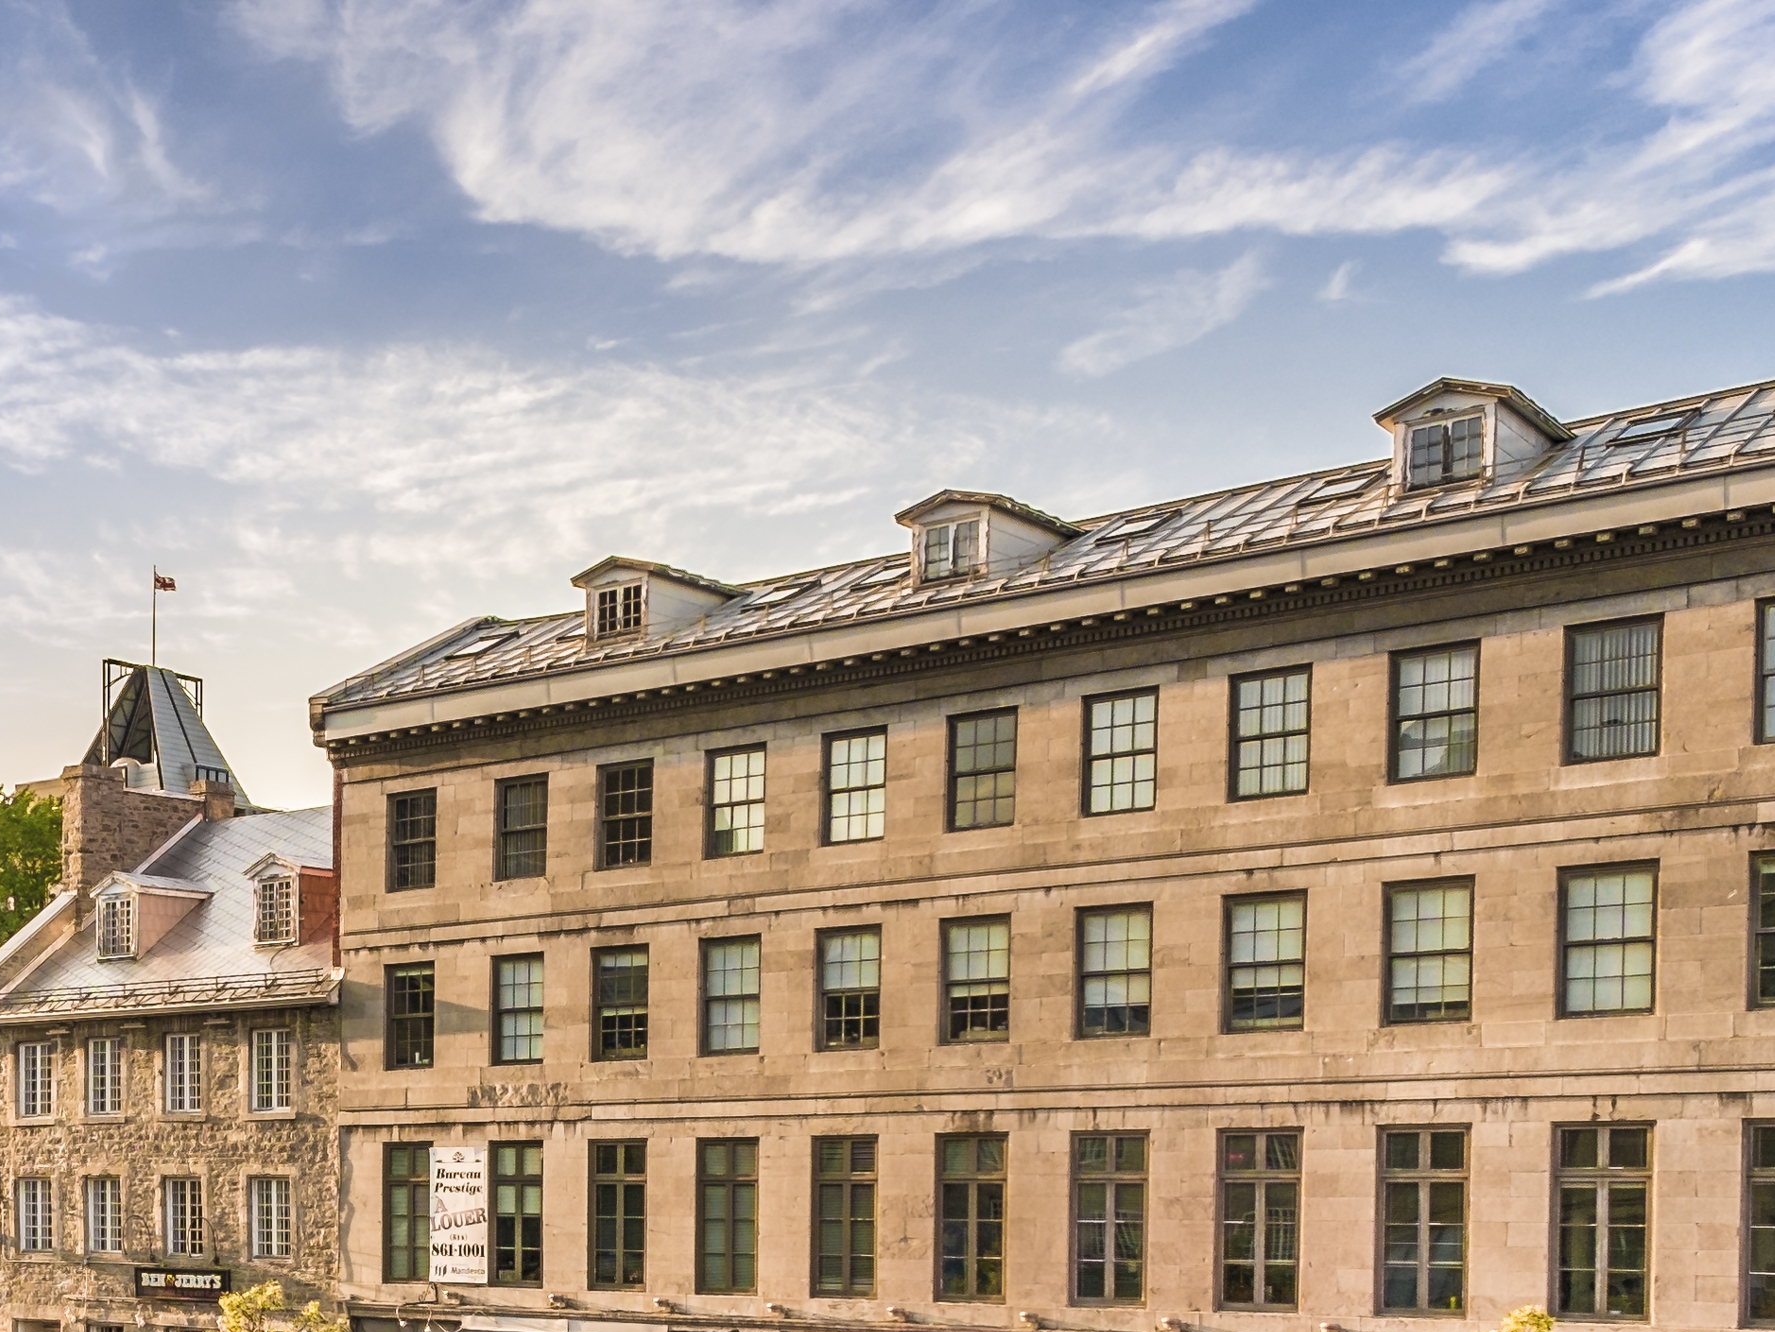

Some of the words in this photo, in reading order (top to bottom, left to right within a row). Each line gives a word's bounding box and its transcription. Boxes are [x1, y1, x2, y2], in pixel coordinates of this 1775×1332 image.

[436, 1168, 481, 1179] Bureau
[434, 1182, 483, 1195] Prestige
[430, 1208, 487, 1232] LOUER
[432, 1242, 485, 1257] 861-1001
[175, 1274, 221, 1289] JERRY'S
